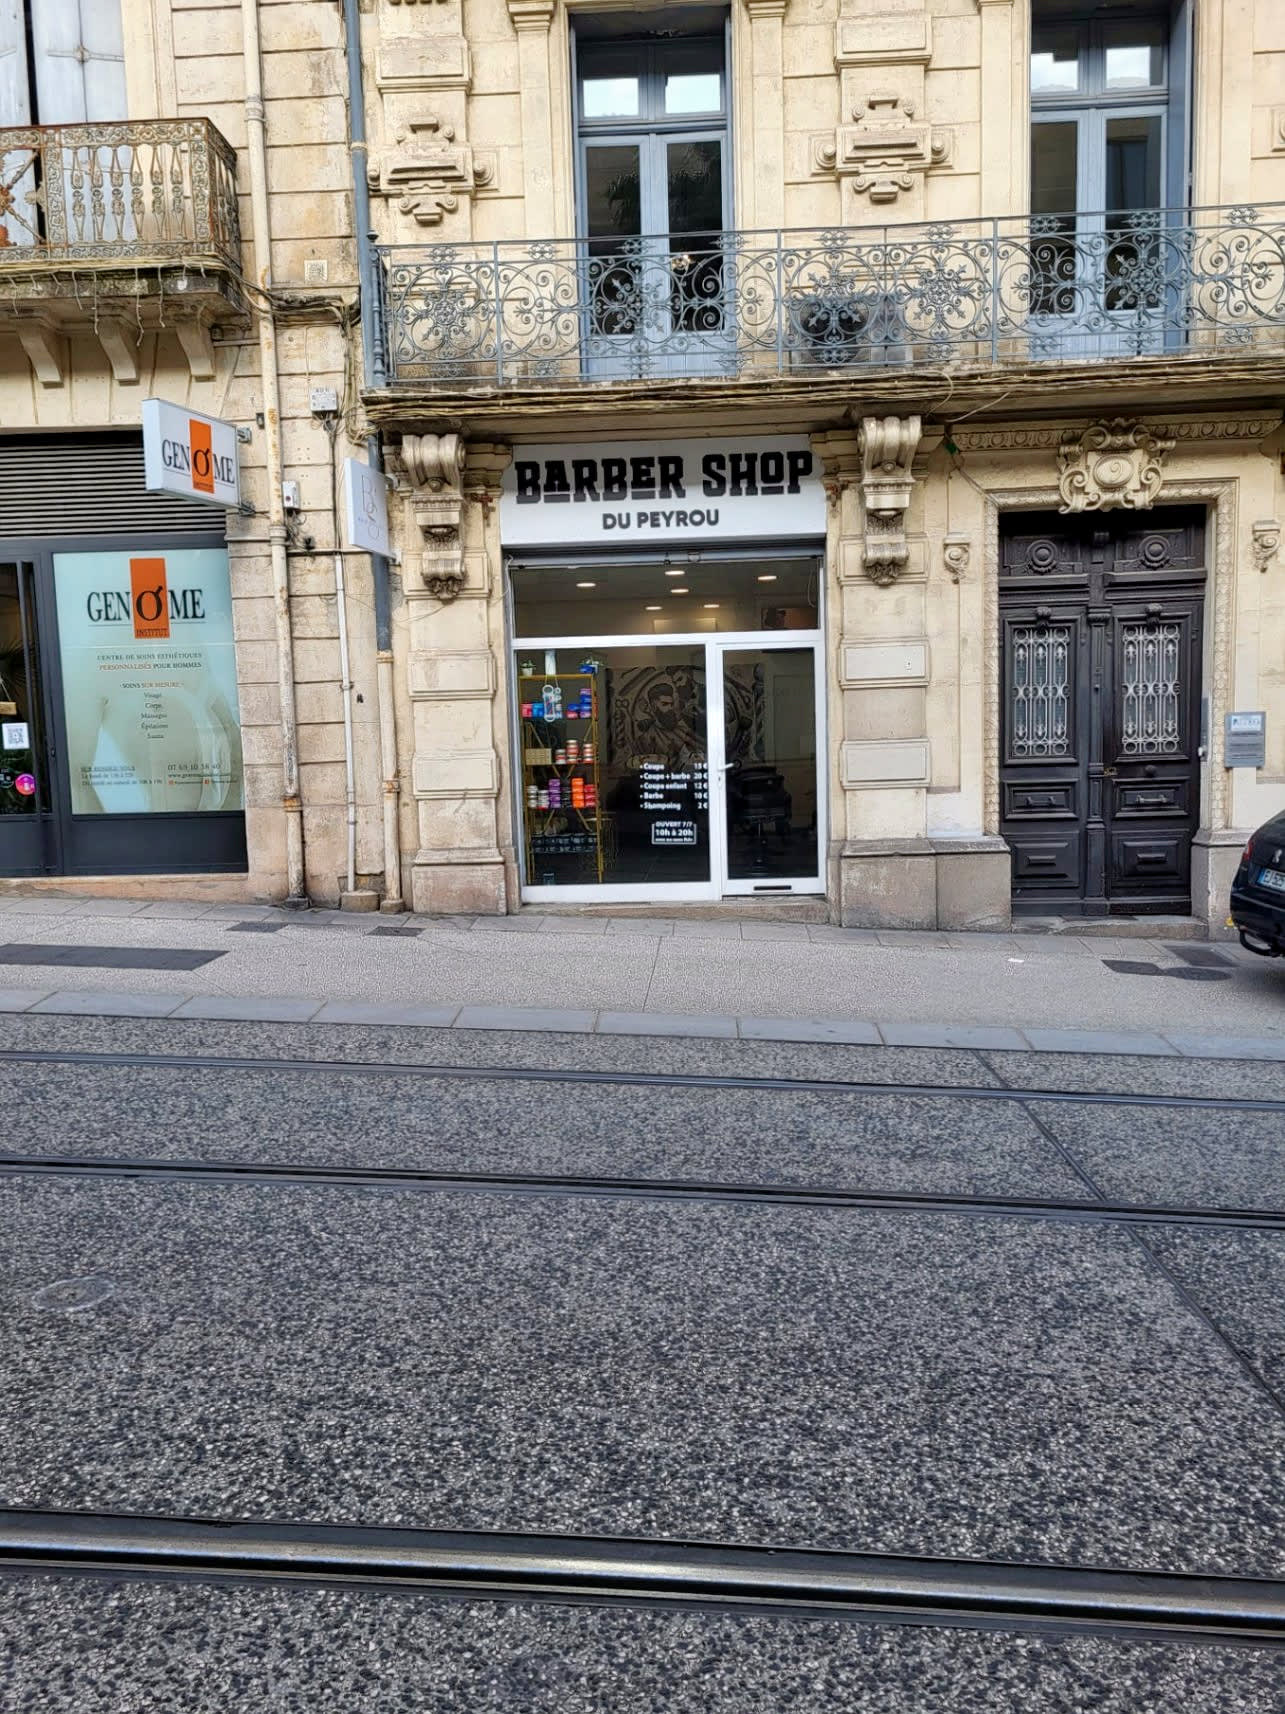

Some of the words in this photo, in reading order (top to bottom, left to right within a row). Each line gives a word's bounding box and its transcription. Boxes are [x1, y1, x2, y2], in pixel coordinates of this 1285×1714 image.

[514, 456, 686, 504] BARBER
[702, 450, 813, 497] SHOP
[602, 512, 631, 530] DU
[637, 509, 720, 529] PEYROU
[643, 763, 665, 771] Coupe
[643, 773, 665, 781] Coupe
[671, 772, 691, 780] barbe
[643, 783, 665, 791] Coupe
[665, 782, 687, 790] enfant
[643, 792, 664, 800] Barbe
[643, 802, 681, 810] Shampoing
[655, 829, 670, 837] 10h
[671, 828, 677, 837] à
[678, 829, 693, 837] 20h
